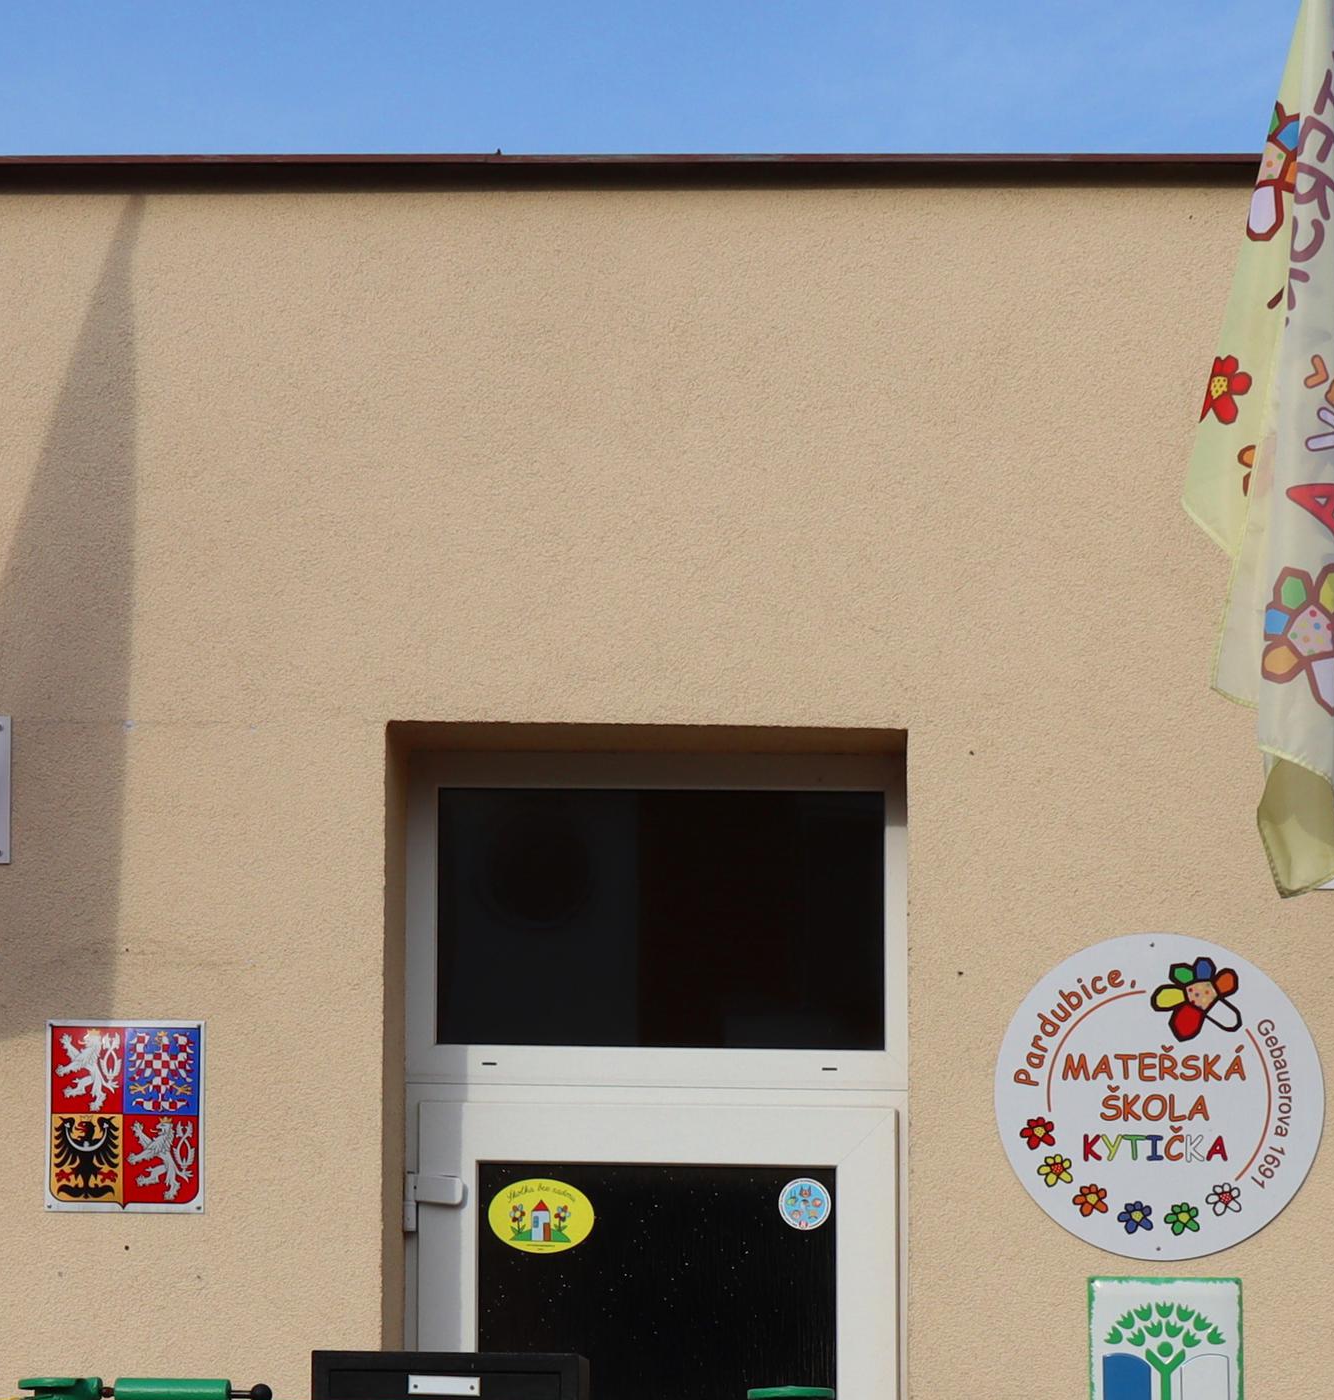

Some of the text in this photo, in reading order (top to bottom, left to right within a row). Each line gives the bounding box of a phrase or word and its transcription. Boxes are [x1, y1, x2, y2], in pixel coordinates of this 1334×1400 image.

[1013, 968, 1137, 1087] Pardubice,
[1061, 1044, 1246, 1082] MATEŘSKÁ
[1100, 1084, 1210, 1122] ŠKOLA
[1251, 1018, 1293, 1189] Gebauerova 1691
[1083, 1125, 1228, 1162] KYTIČKA
